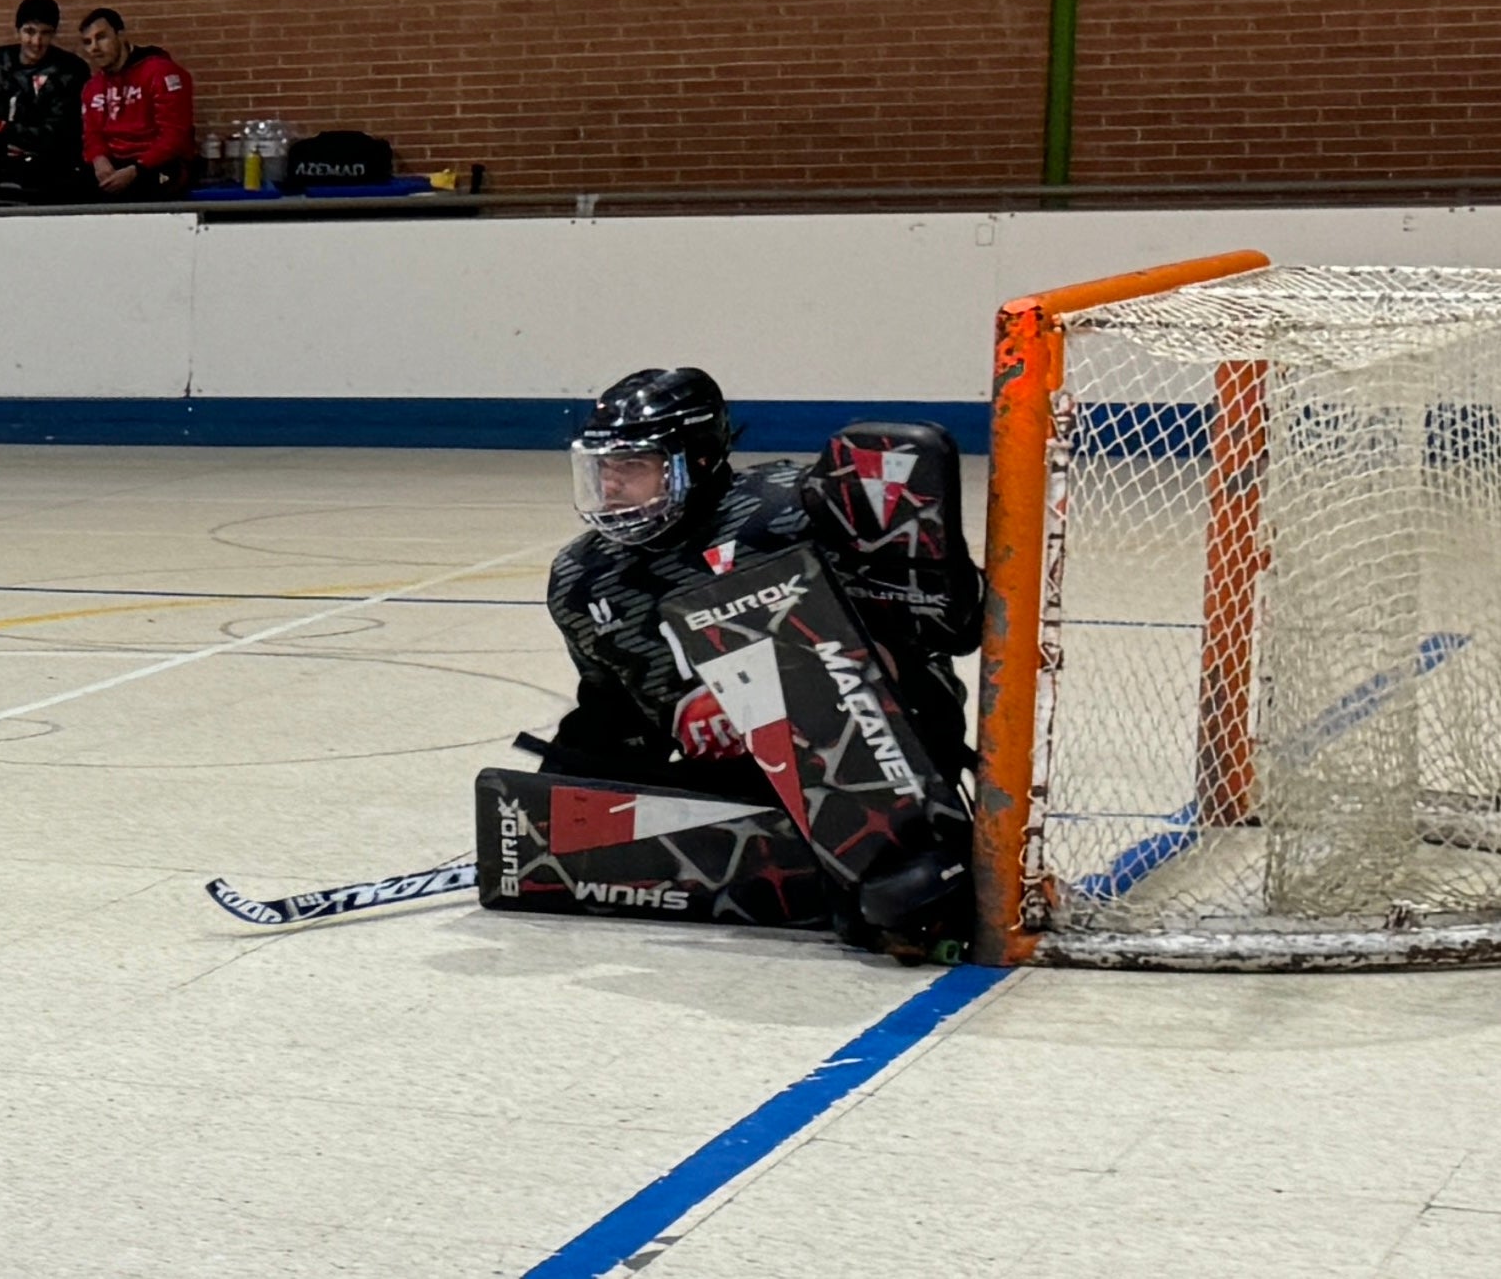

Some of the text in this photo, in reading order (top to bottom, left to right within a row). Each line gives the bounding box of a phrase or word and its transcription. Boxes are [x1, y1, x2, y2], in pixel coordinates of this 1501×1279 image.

[685, 574, 809, 632] BUROK
[815, 640, 925, 800] MAÇANET
[499, 796, 521, 897] BUROK
[575, 880, 690, 911] SHUM
